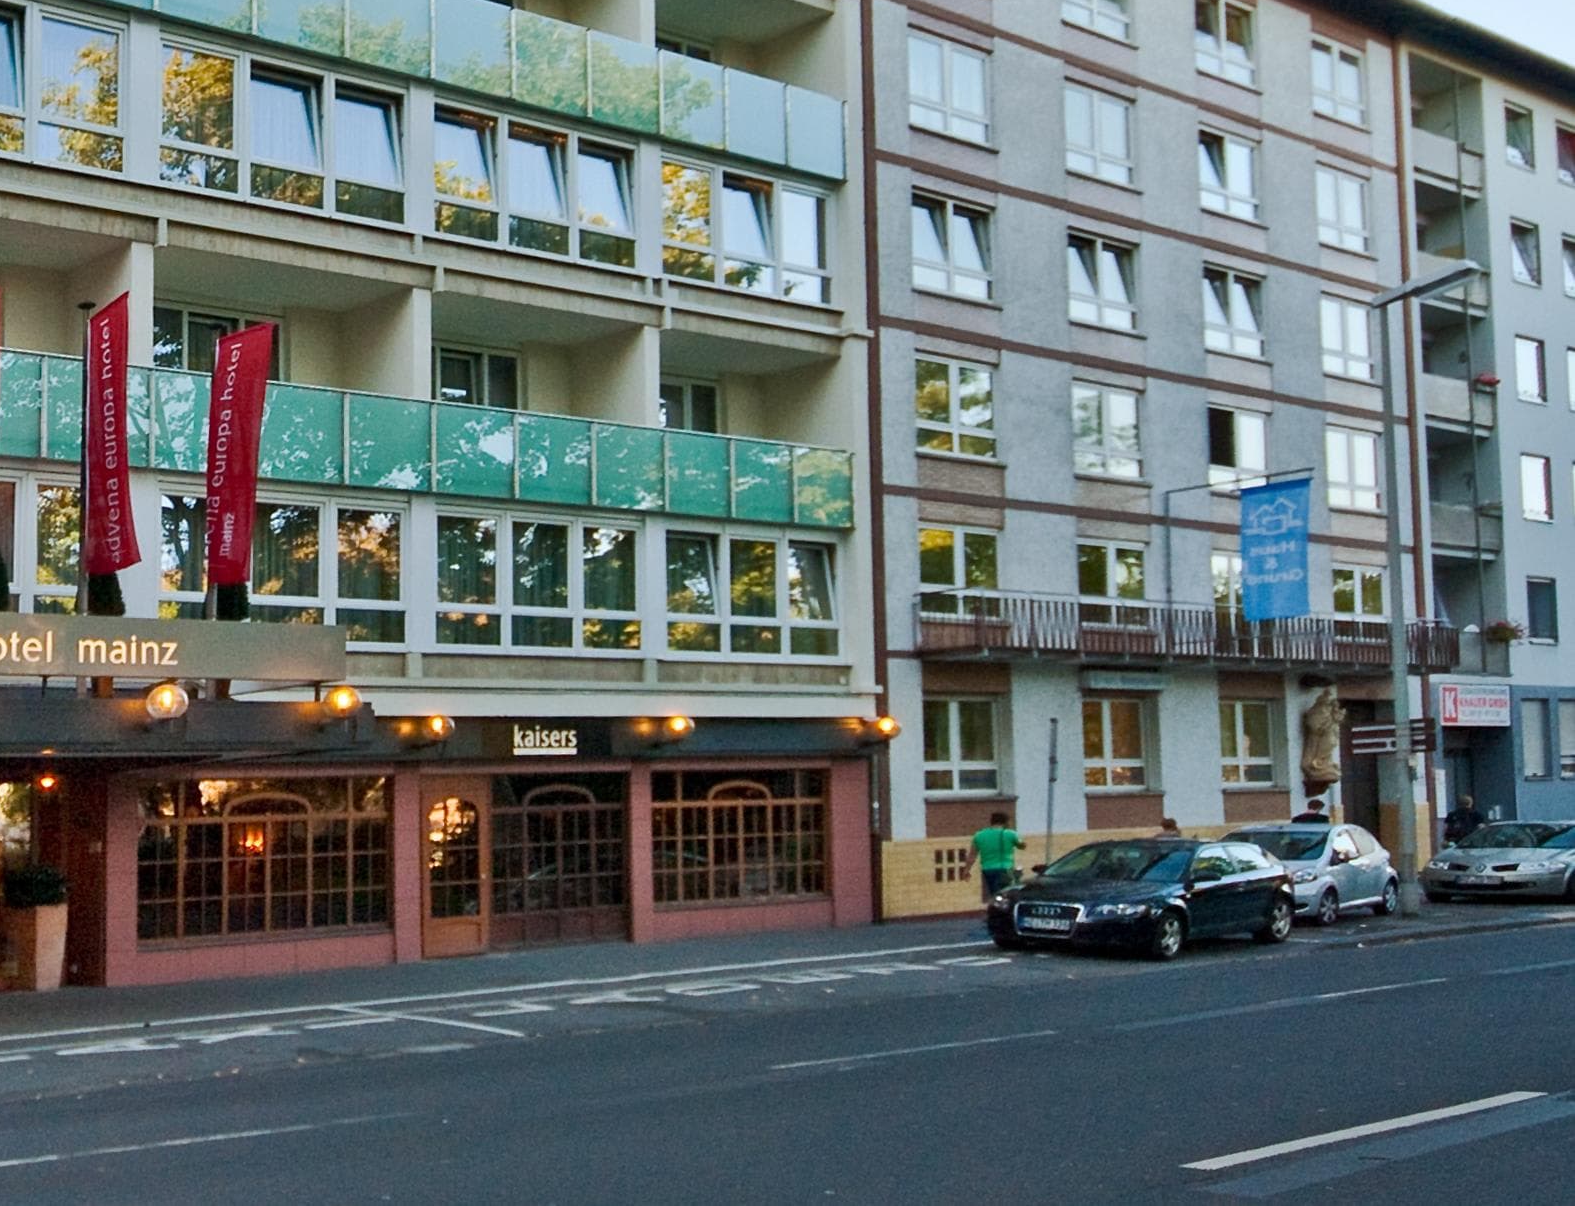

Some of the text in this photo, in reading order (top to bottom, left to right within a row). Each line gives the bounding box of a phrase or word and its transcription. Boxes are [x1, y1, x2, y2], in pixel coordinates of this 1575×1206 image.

[212, 409, 232, 488] europa
[104, 480, 121, 564] advena
[218, 512, 235, 558] mainz
[77, 635, 178, 666] mainz
[513, 724, 578, 750] kaisers
